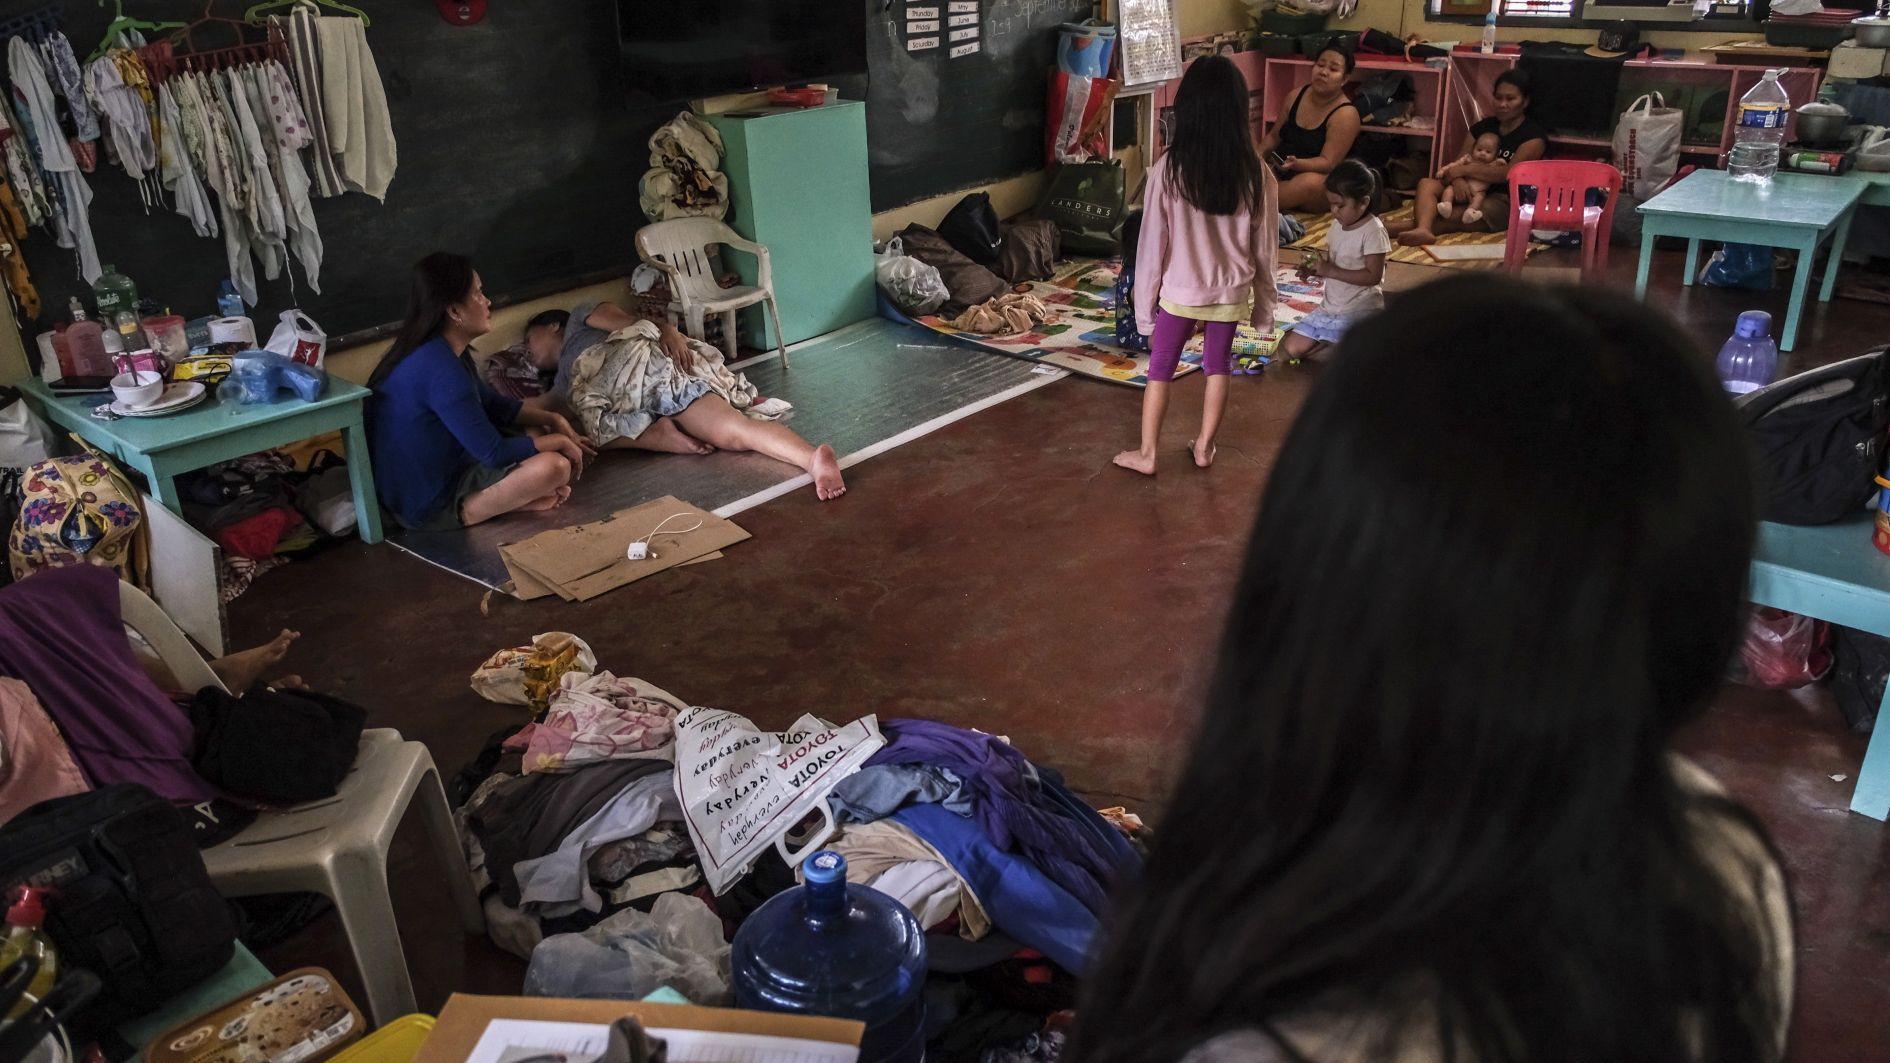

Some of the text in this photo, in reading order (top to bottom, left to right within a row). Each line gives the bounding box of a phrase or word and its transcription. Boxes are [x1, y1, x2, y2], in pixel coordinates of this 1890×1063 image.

[679, 706, 711, 729] YOTA
[775, 729, 812, 745] YOTA
[693, 736, 761, 778] everyday
[777, 729, 839, 770] TOYOTA
[788, 745, 847, 788] TOYOTA
[706, 767, 769, 815] veryday
[709, 758, 759, 789] veryday
[728, 794, 780, 846] everyday
